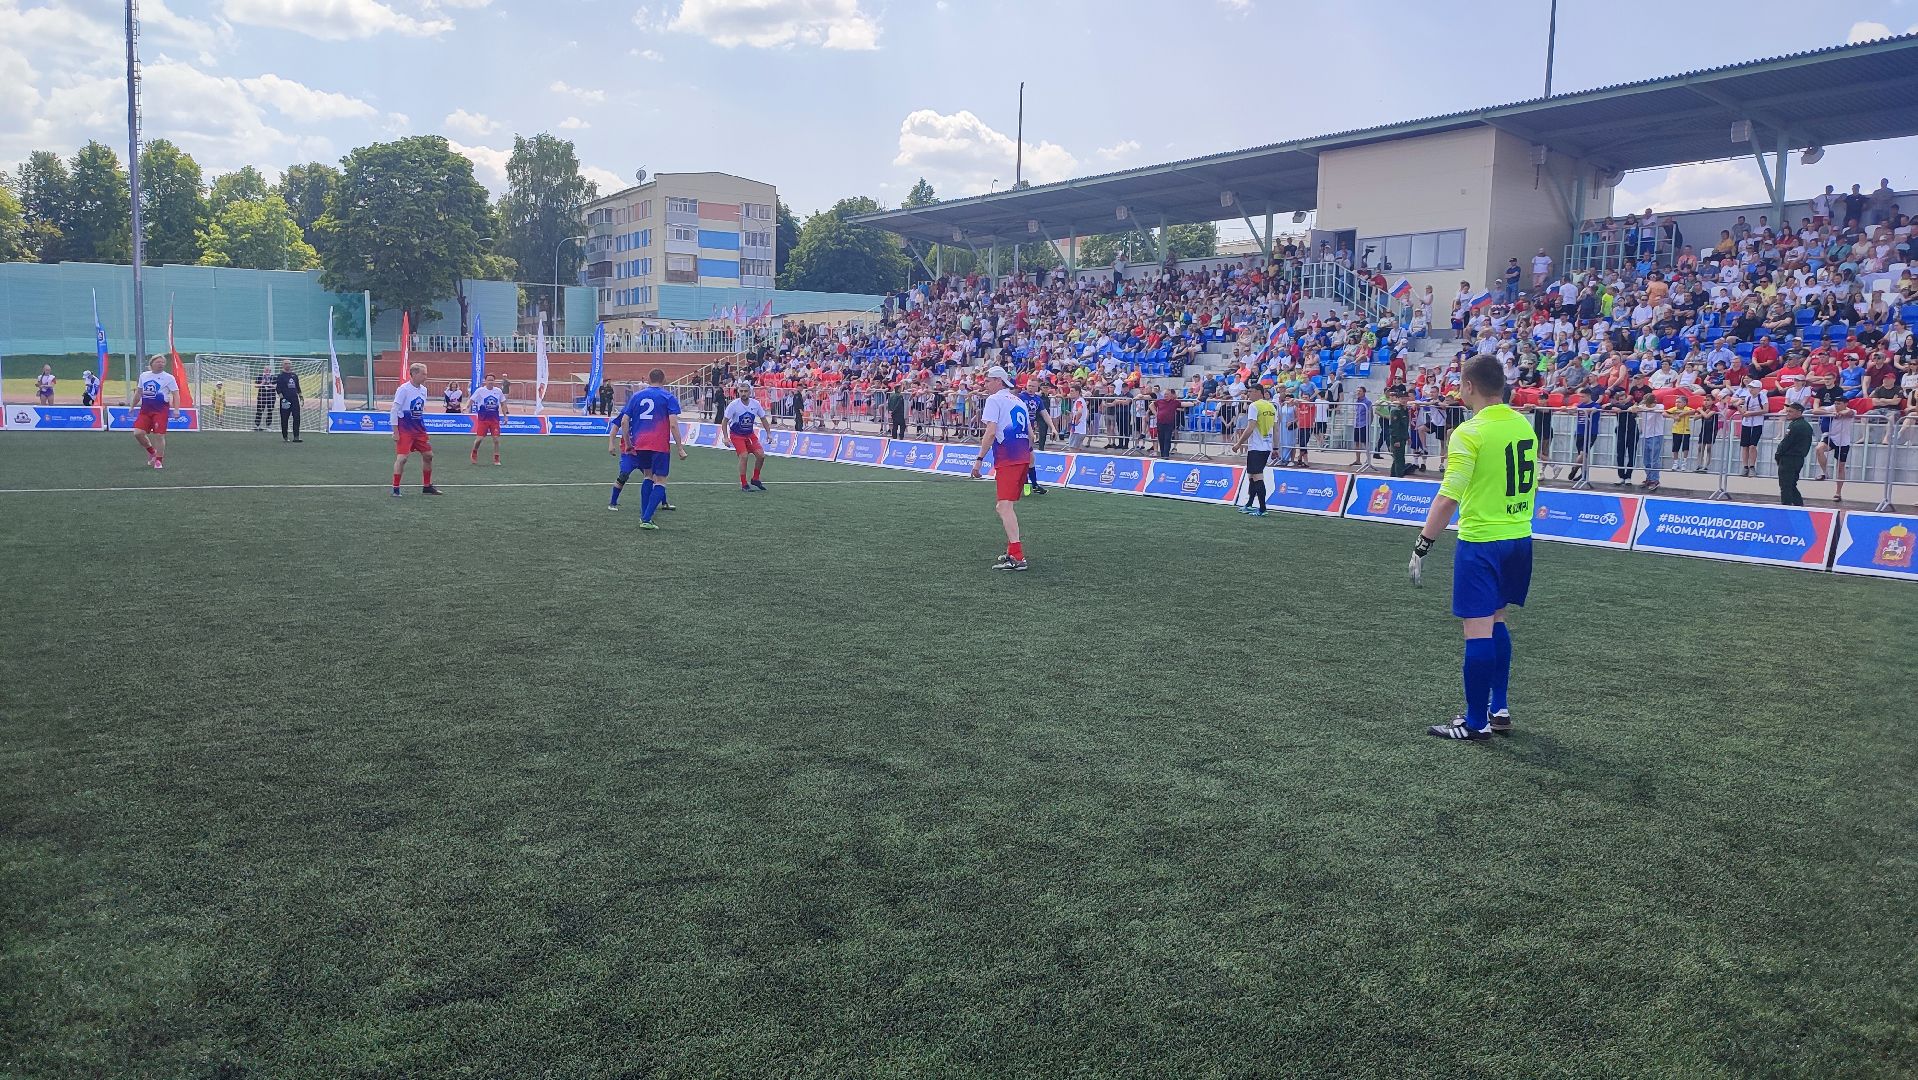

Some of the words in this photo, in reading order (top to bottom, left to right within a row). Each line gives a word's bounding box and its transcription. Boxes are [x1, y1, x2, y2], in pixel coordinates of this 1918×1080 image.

[639, 398, 655, 420] 2
[1016, 411, 1026, 431] 9
[1505, 439, 1534, 497] 16
[1396, 492, 1431, 505] Команда
[1392, 503, 1430, 515] Губернат
[1659, 513, 1765, 530] #ВЫХОДИВОДВОР
[1656, 523, 1806, 547] #КОМАНДАГУБЕРНАТОРА
